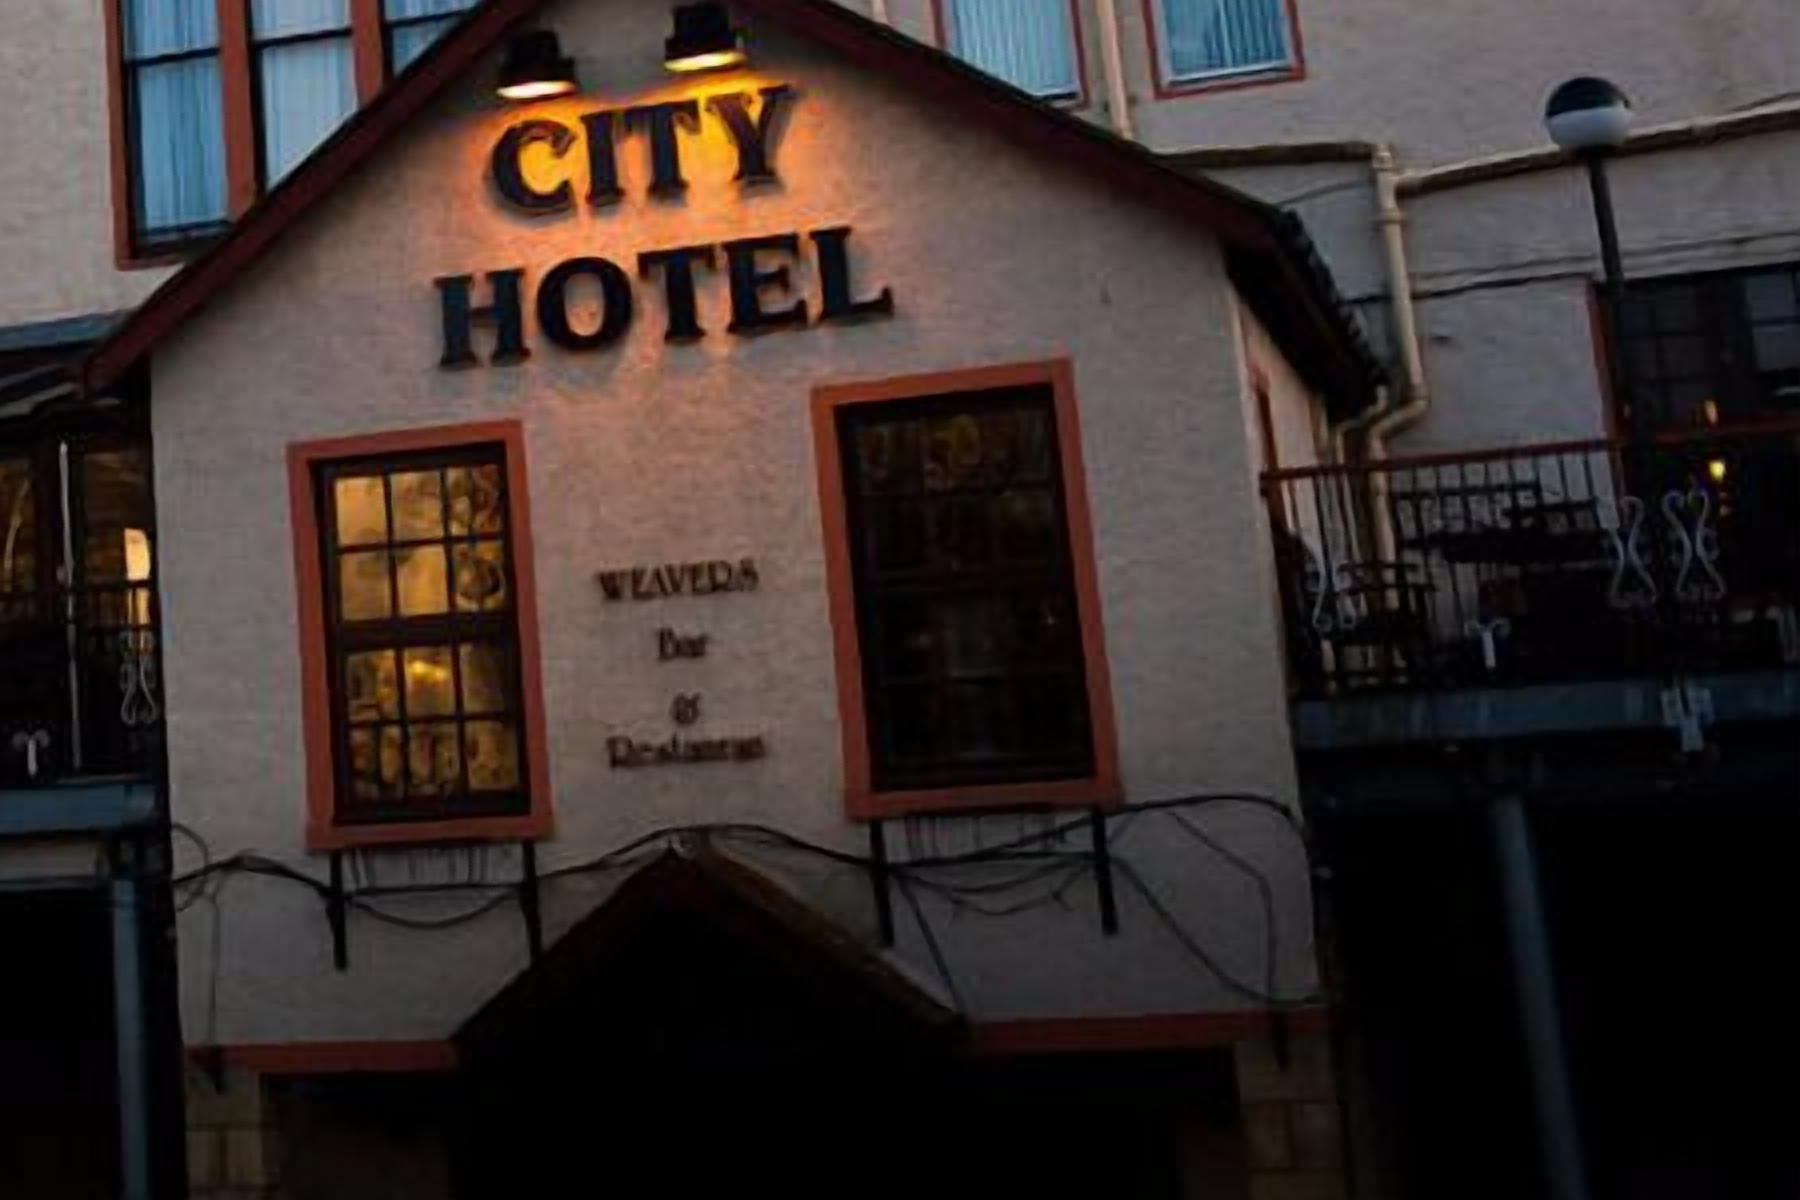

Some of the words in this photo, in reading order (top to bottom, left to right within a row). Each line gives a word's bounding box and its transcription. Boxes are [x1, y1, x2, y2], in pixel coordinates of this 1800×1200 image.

[490, 85, 796, 215] CITY
[434, 227, 894, 368] HOTEL
[597, 558, 759, 601] WEAVERS
[656, 625, 710, 664] Bar
